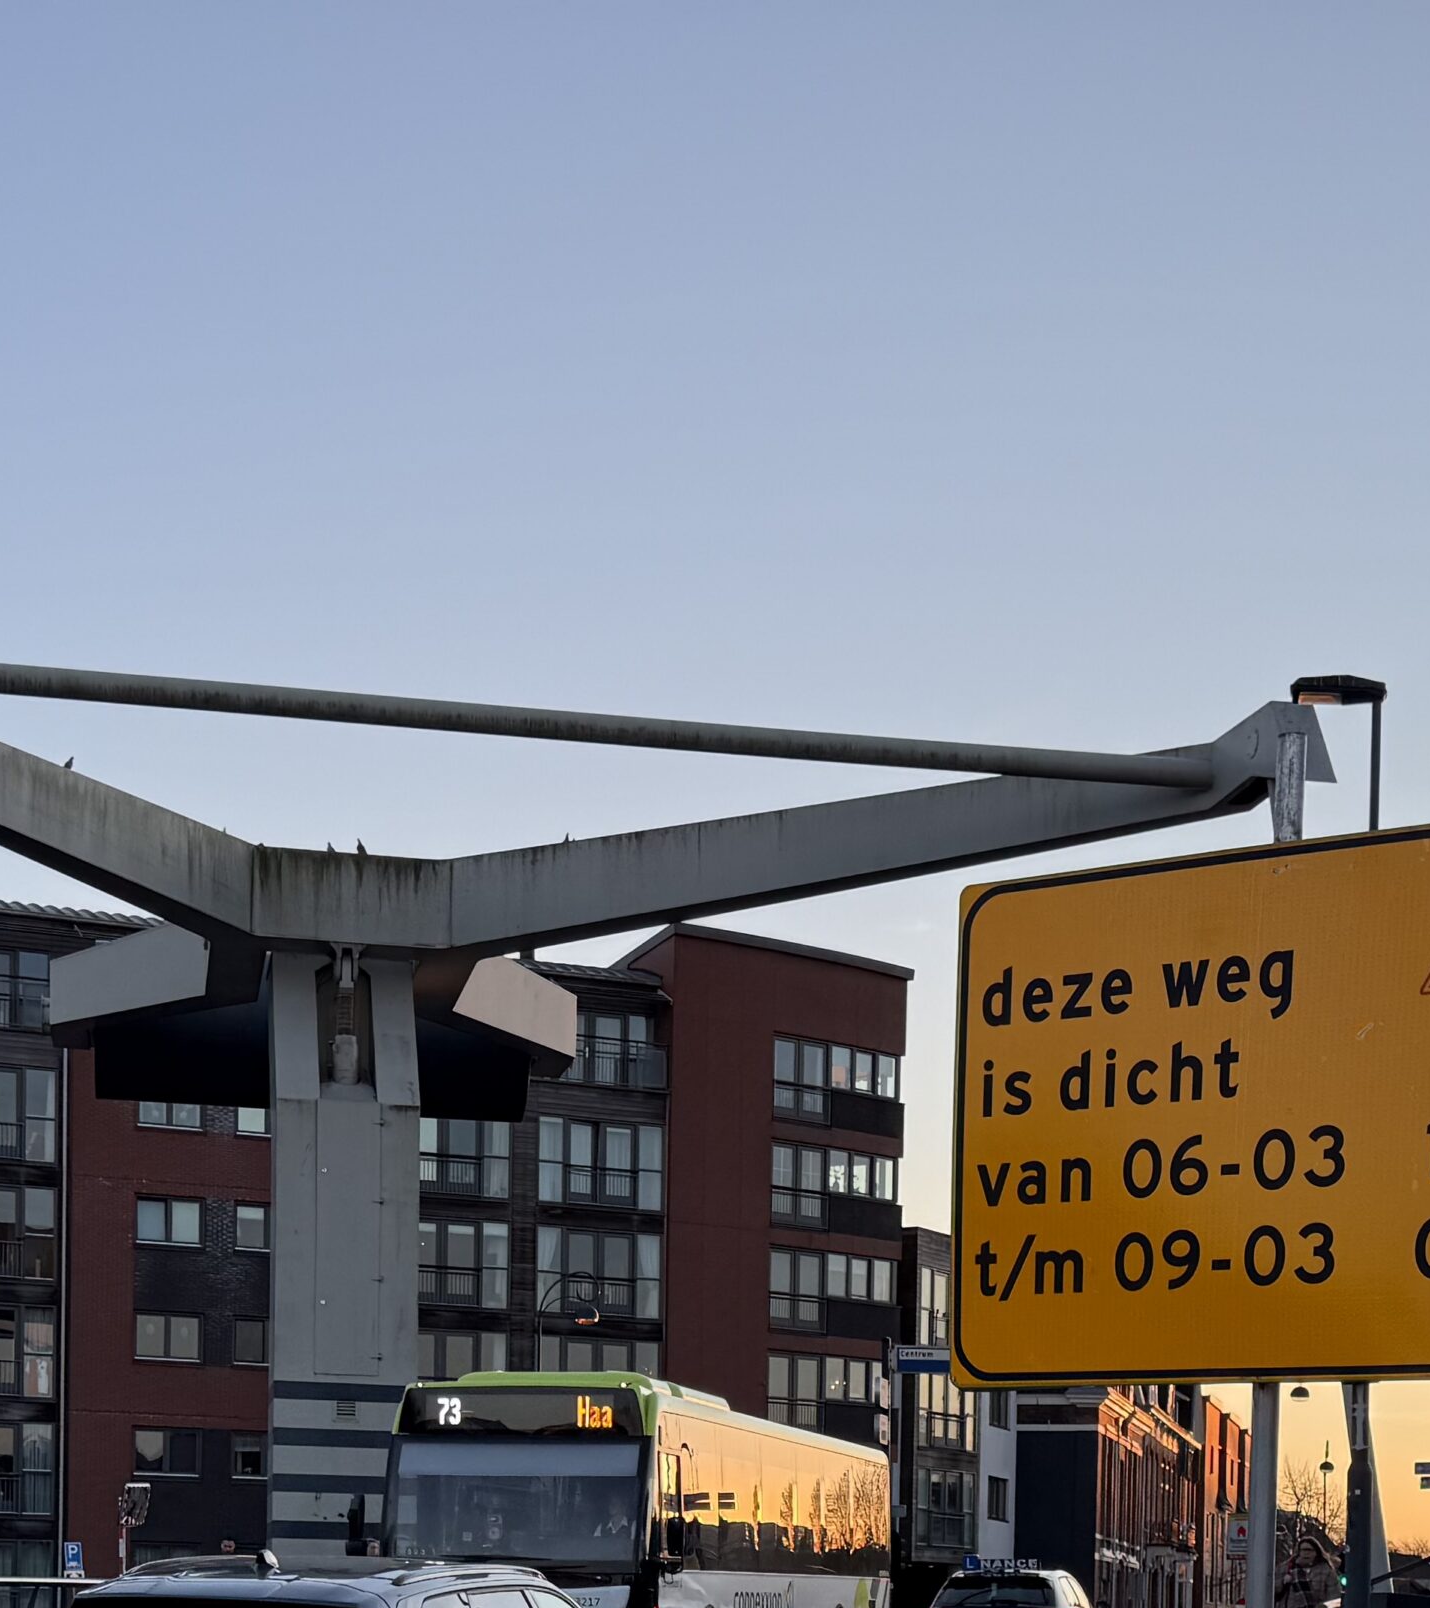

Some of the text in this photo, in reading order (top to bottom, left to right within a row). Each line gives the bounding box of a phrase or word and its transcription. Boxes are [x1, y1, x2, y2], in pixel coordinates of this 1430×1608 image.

[981, 949, 1295, 1027] deze weg
[981, 1037, 1241, 1118] is dicht
[976, 1153, 1093, 1207] van
[1121, 1124, 1346, 1199] 06-03
[974, 1233, 1084, 1301] t/m
[1113, 1222, 1336, 1291] 09-03
[900, 1350, 934, 1358] Centrum
[436, 1395, 613, 1429] 73 Haa
[67, 1544, 79, 1559] P
